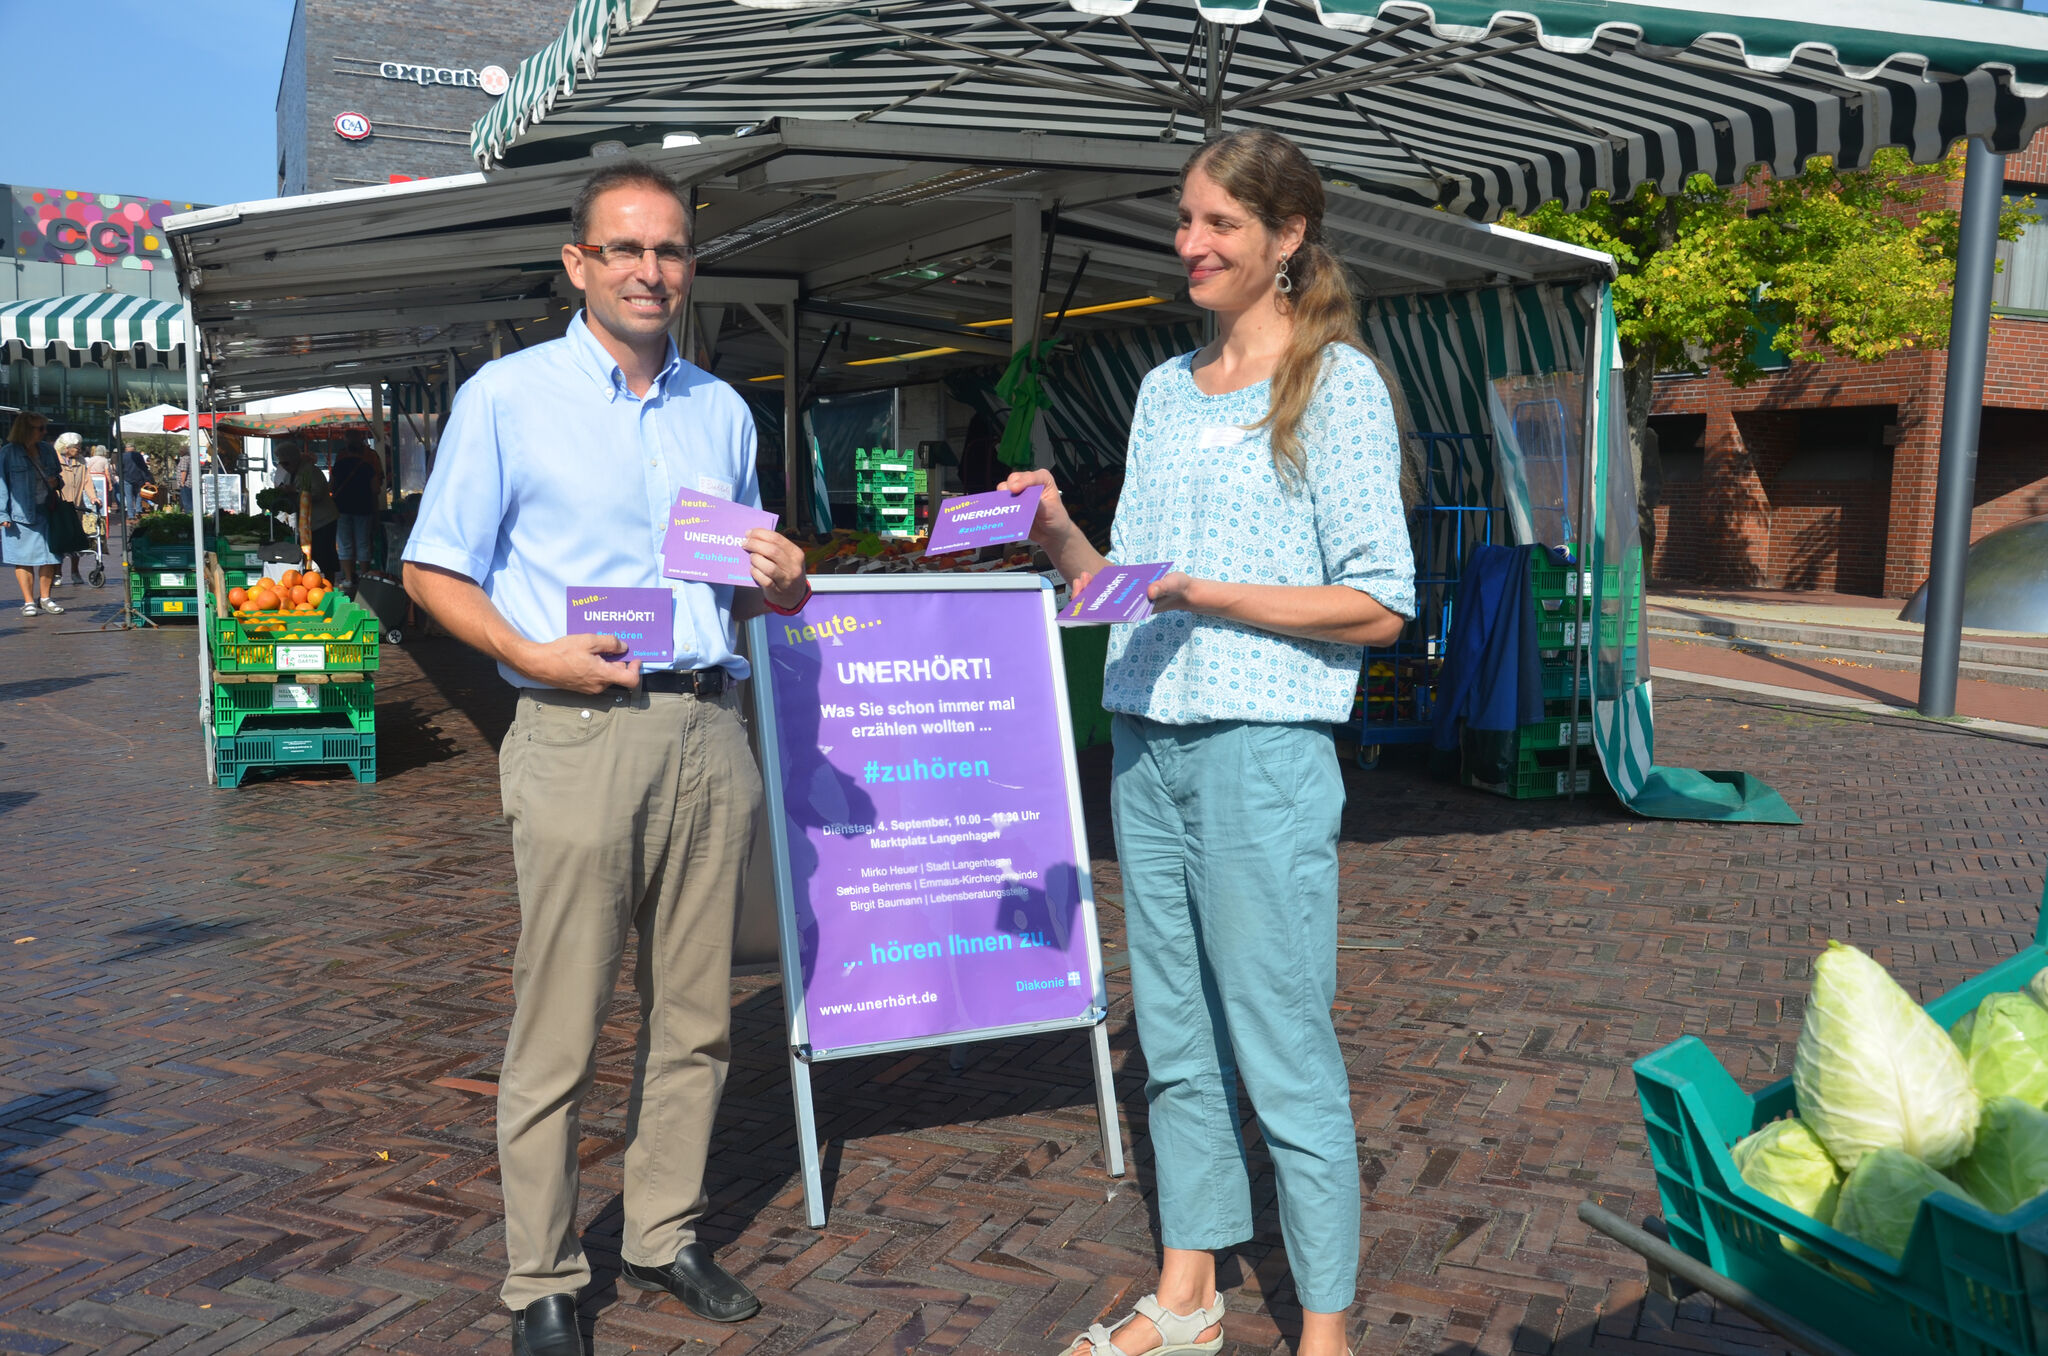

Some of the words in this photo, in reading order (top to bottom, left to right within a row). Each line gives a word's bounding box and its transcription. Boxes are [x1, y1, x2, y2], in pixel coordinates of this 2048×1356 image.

[382, 63, 476, 85] expert
[341, 118, 364, 132] C&A
[46, 218, 162, 258] CCL
[951, 504, 1021, 522] UNERHÖRT!
[959, 522, 1004, 534] #zuhören
[694, 551, 739, 564] #zuhören
[1088, 573, 1128, 611] UNERHÖRT!
[584, 610, 655, 622] UNERHÖRT!
[784, 614, 882, 646] heute...
[837, 654, 992, 685] UNERHÖRT!
[820, 704, 855, 719] Was
[859, 702, 884, 717] Sie
[888, 700, 935, 716] schon
[938, 699, 985, 713] immer
[988, 696, 1016, 711] mal
[851, 722, 917, 738] erzählen
[921, 718, 975, 735] wollten
[863, 756, 989, 784] #zuhören
[822, 823, 876, 836] Dienstag,
[877, 821, 888, 832] 4.
[890, 817, 952, 833] September,
[954, 815, 981, 826] 10.00
[1021, 810, 1041, 821] Uhr
[870, 836, 927, 850] Marktplatz
[929, 831, 1001, 845] Langenhagen
[861, 867, 888, 878] Mirko
[889, 865, 919, 877] Heuer
[926, 860, 951, 873] Stadt
[952, 857, 1012, 871] Langenhagen
[836, 884, 870, 896] Sabine
[872, 881, 912, 893] Behrens
[850, 899, 876, 912] Birgit
[877, 896, 923, 909] Baumann
[929, 885, 1029, 904] Lebensberatungsstelle
[871, 941, 942, 965] hören
[948, 932, 1013, 957] Ihnen
[1018, 931, 1051, 949] zu.
[1015, 977, 1065, 992] Diakonie
[819, 991, 938, 1017] www.unerhört.de
